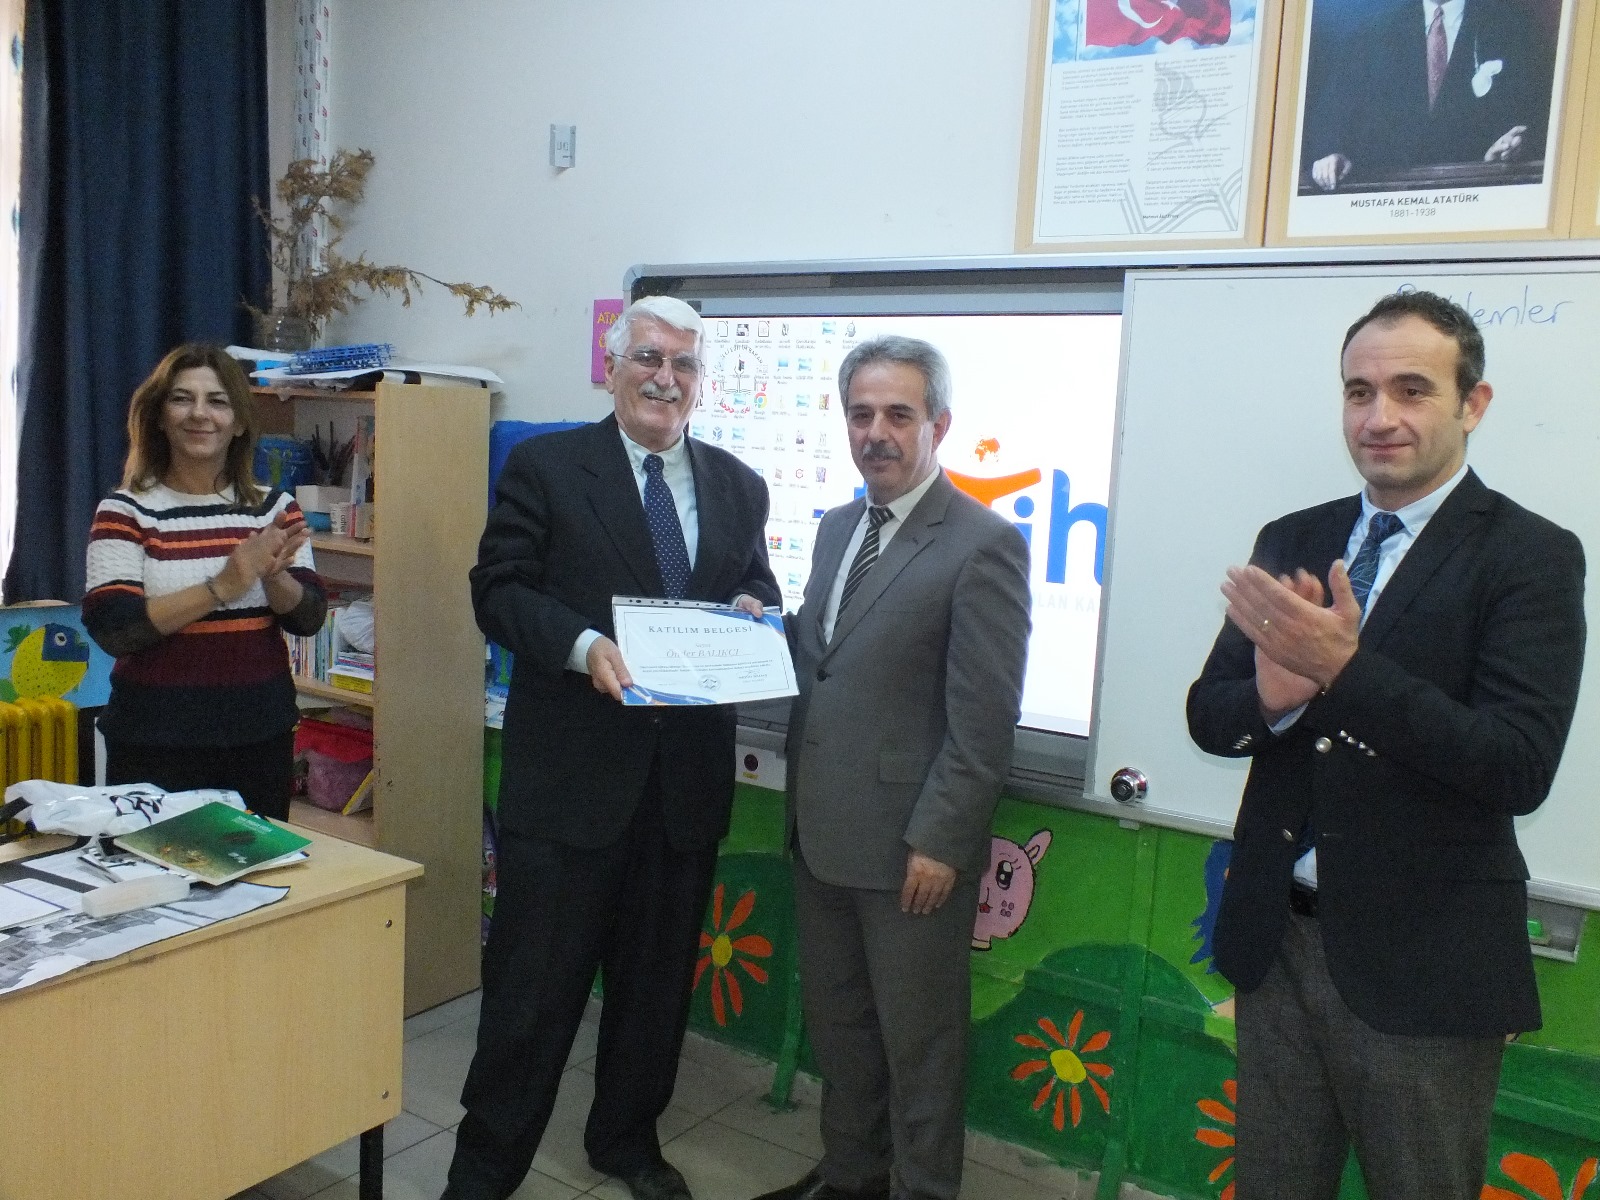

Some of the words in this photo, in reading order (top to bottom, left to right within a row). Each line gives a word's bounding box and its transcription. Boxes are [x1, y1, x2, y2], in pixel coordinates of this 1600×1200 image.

[1350, 198, 1395, 208] MUSTAFA
[1397, 196, 1430, 206] KEMAL
[1433, 193, 1480, 204] ATATÜRK
[1390, 207, 1436, 218] 1881-1938
[648, 625, 699, 634] KATILIM
[703, 624, 753, 634] BELGESİ
